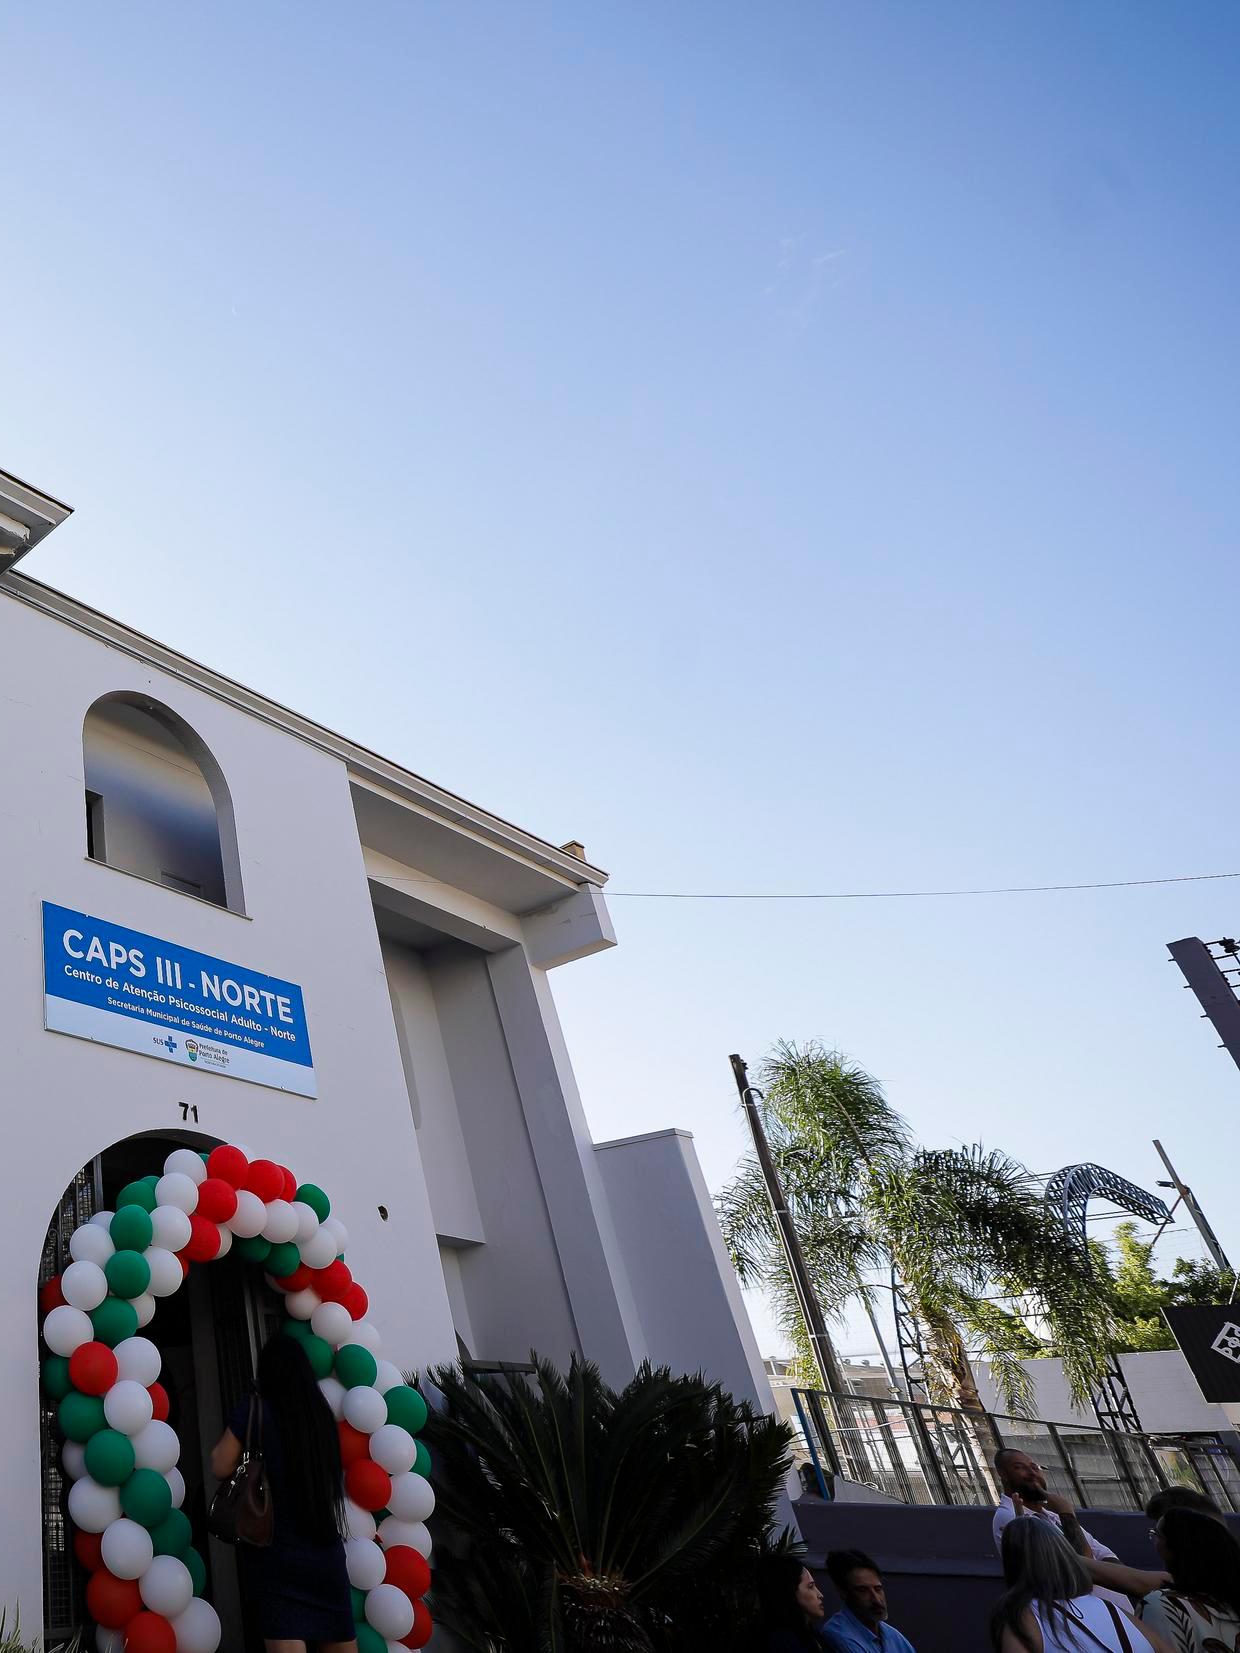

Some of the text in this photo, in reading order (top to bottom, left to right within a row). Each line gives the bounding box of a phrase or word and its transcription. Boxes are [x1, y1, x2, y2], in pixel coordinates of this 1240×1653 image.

[63, 929, 146, 978] CAPS
[156, 957, 182, 990] III
[201, 971, 294, 1024] NORTE
[64, 964, 103, 985] Centro
[105, 977, 120, 990] de
[122, 982, 166, 1003] Atenção
[168, 994, 228, 1022] Psicossocial
[231, 1014, 262, 1032] Adulto
[270, 1025, 296, 1042] Norte
[107, 996, 265, 1049] Secretaria Municipal de Saúde de Porto Alegre
[152, 1037, 164, 1046] SUS
[199, 1050, 213, 1059] Porto
[213, 1053, 230, 1064] Alegre
[178, 1101, 199, 1124] 71
